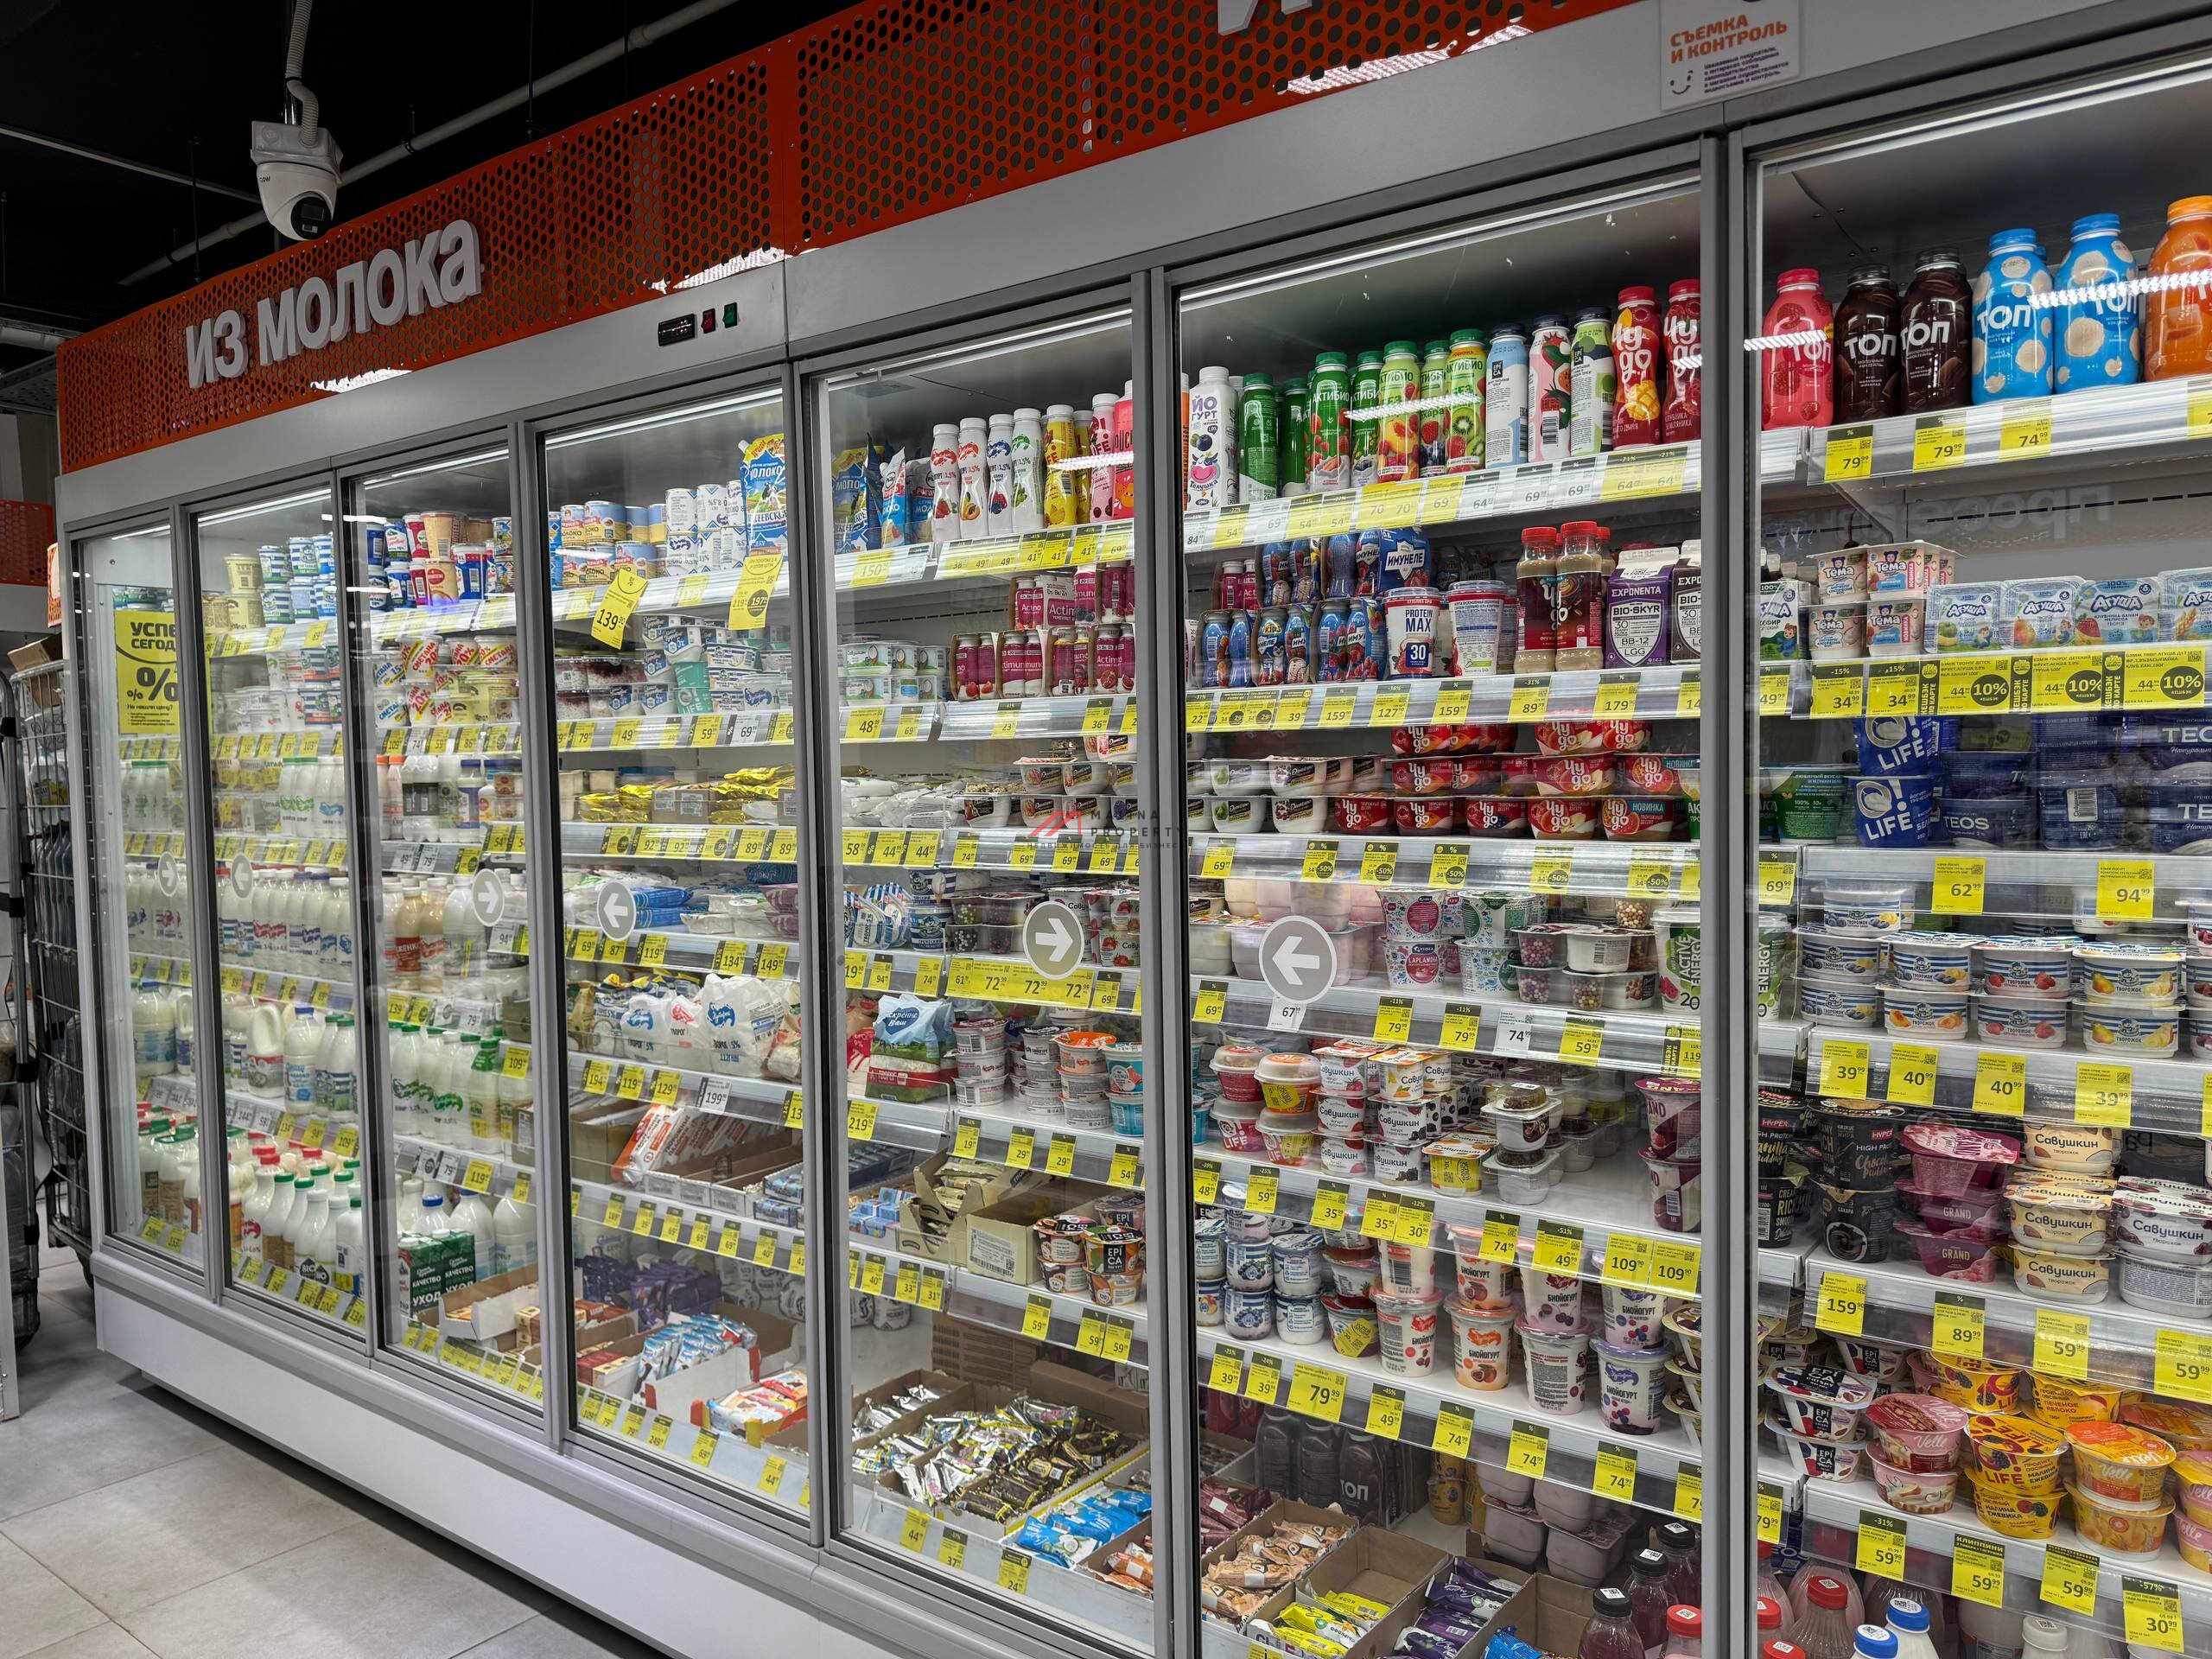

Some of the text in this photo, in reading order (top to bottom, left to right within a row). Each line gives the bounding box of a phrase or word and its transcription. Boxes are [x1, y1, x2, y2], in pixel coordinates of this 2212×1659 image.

[1670, 14, 1749, 48] СЪЕМКА
[1671, 21, 1788, 64] И КОНТРОЛЬ
[1976, 304, 2032, 334] ТОП
[1900, 321, 1951, 351] ТОП
[1844, 334, 1897, 359] ТОП
[1192, 395, 1217, 410] ЙО
[1312, 391, 1350, 404] АКТИБИО
[1192, 410, 1217, 421] ГУРТ
[1388, 554, 1423, 566] ИМУНЕЛЕ
[1406, 609, 1433, 618] PROTEIN
[1613, 605, 1661, 615] BIO-SKYR
[130, 621, 176, 638] УСПЕ
[1406, 618, 1431, 632] MAX
[131, 639, 176, 651] СЕГОД
[1624, 647, 1646, 656] LGG
[1410, 645, 1427, 660] 30
[2069, 679, 2101, 692] 10%
[2163, 675, 2202, 689] 10%
[1974, 683, 2006, 696] 10%
[2162, 727, 2212, 743] TEO
[1877, 738, 1925, 771] LIFE
[1633, 803, 1663, 812] НОВИНКА
[1865, 811, 1913, 841] LIFE
[1942, 816, 1990, 831] TEOS
[1681, 934, 1691, 979] ACTIVE
[888, 1018, 906, 1027] Ваш
[1319, 1106, 1359, 1119] Савушкин
[1224, 1137, 1249, 1148] LIFE
[2035, 1133, 2099, 1148] Савушкин
[1943, 1207, 1971, 1220] GRAND
[2025, 1211, 2092, 1230] Савушкин
[2133, 1219, 2204, 1241] Савушкин
[1942, 1248, 1970, 1262] GRAND
[445, 1266, 474, 1278] КАЧЕСТВО
[2028, 1261, 2095, 1279] Савушкин
[412, 1275, 441, 1287] КАЧЕСТВО
[412, 1291, 441, 1306] УХОД
[1865, 1357, 1878, 1365] CA
[1815, 1415, 1829, 1425] CA
[1915, 1434, 1947, 1448] Velle
[1818, 1457, 1833, 1465] CA
[1985, 1471, 2024, 1485] LIFE
[1874, 1518, 1893, 1528] -31%
